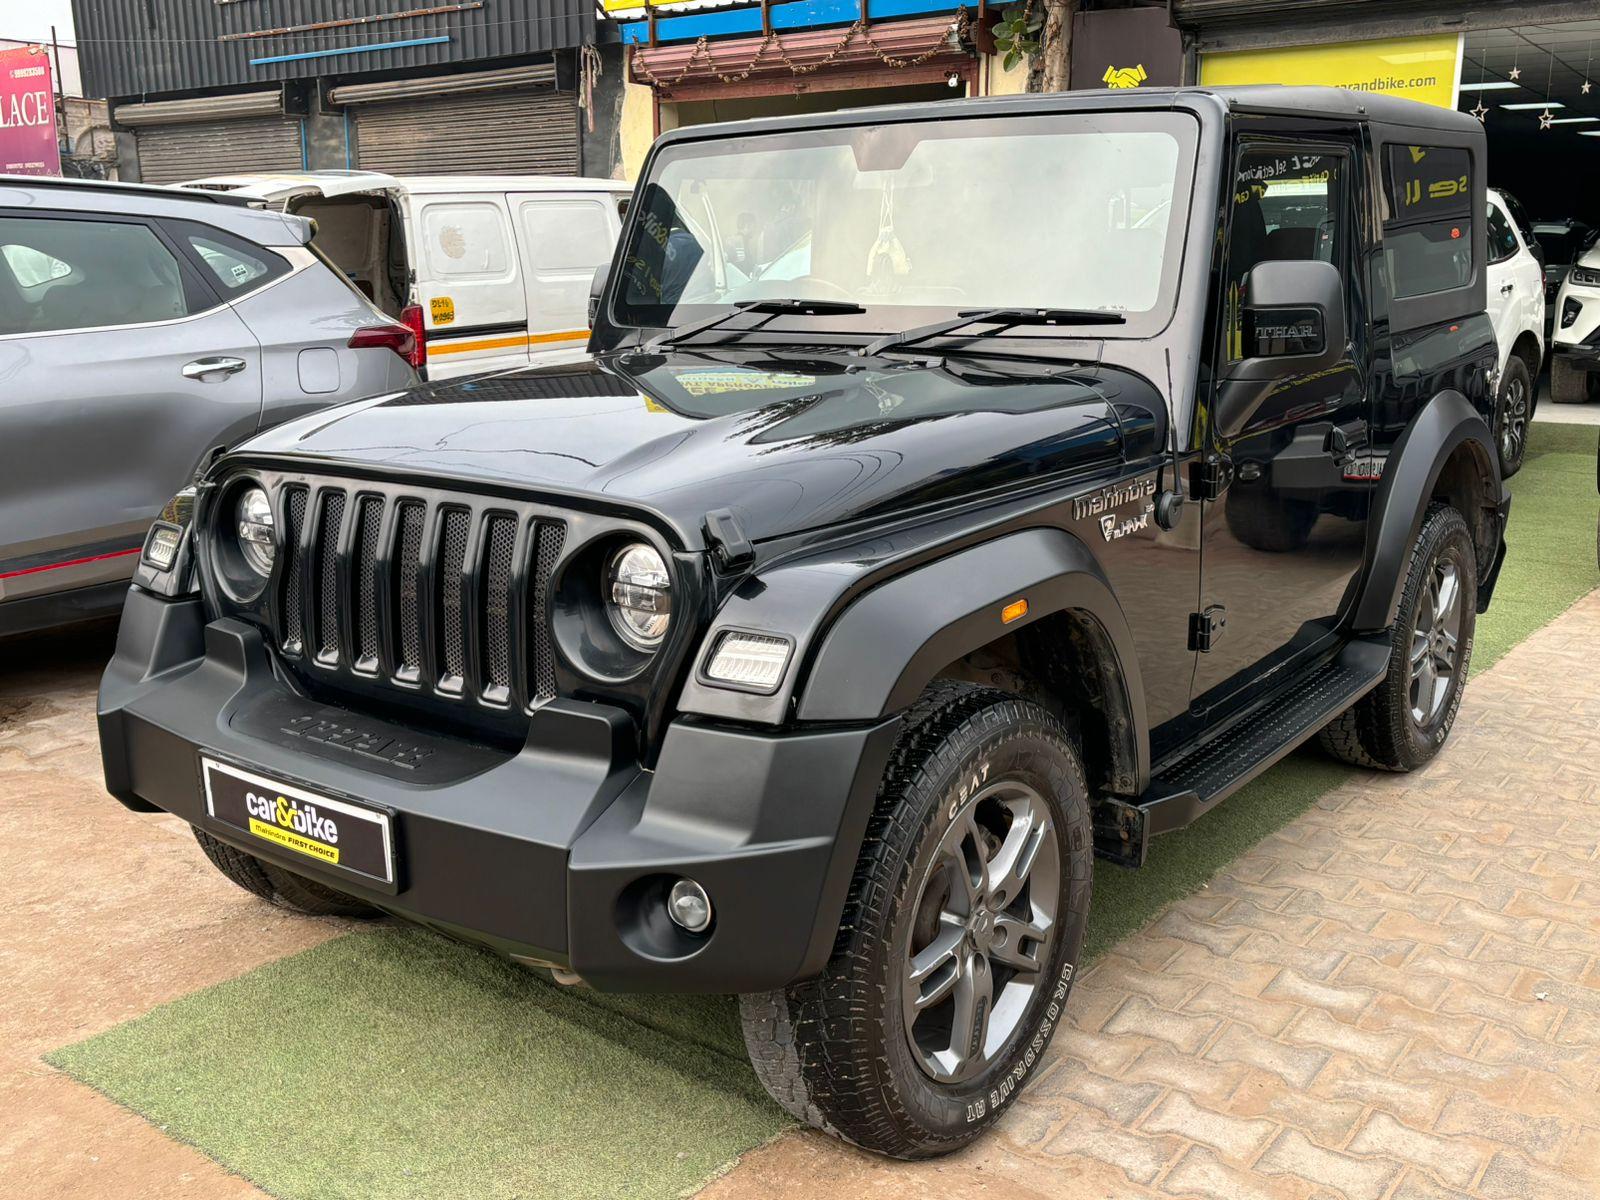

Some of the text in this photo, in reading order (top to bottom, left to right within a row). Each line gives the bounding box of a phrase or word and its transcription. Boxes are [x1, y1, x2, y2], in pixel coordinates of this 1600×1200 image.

[1255, 325, 1317, 339] THAR
[949, 763, 990, 820] CEAT
[246, 792, 339, 844] car&bike
[287, 837, 309, 849] FIRST
[308, 844, 336, 859] CHOICE
[966, 962, 1074, 1123] CROSSDRIVE AT
